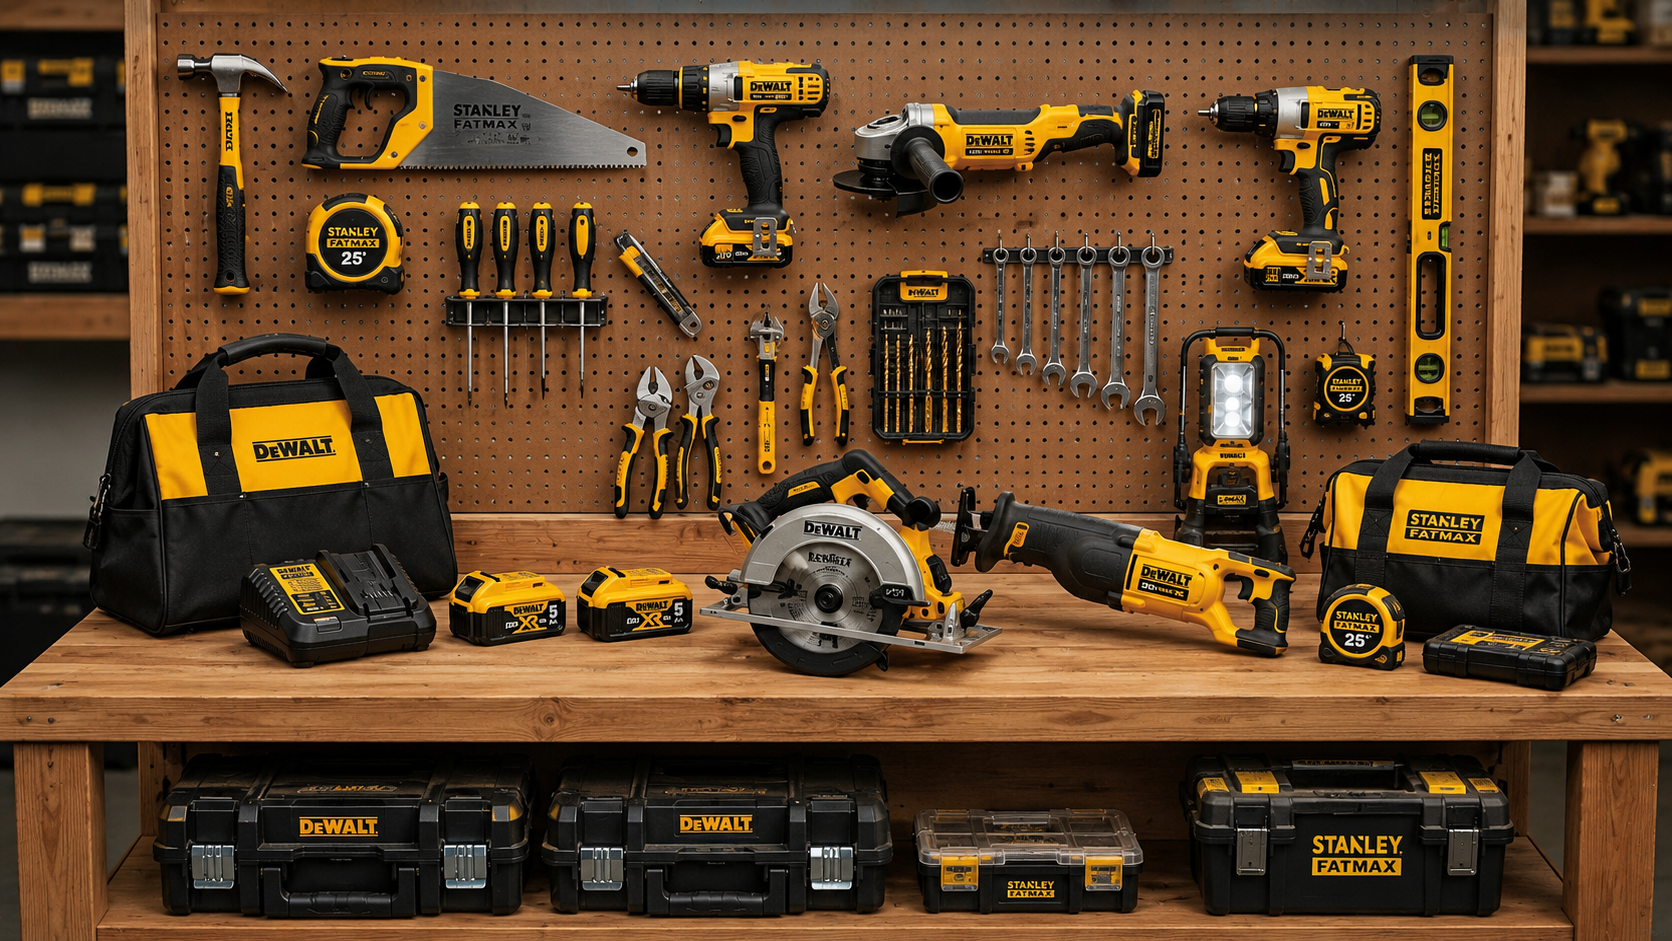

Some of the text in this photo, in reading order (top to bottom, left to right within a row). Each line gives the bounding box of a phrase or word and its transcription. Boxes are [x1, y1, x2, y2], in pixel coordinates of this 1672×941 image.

[453, 104, 521, 117] STANLEY
[454, 120, 518, 130] FATMAX
[328, 227, 379, 237] STANLEY
[341, 251, 367, 265] 25'
[1410, 513, 1482, 530] STANLEY
[1409, 528, 1477, 543] FATMAX
[1336, 611, 1378, 623] STANLEY
[1336, 621, 1377, 632] FATMAX
[1317, 860, 1397, 873] FATMAX
[1007, 881, 1055, 889] STANLEY
